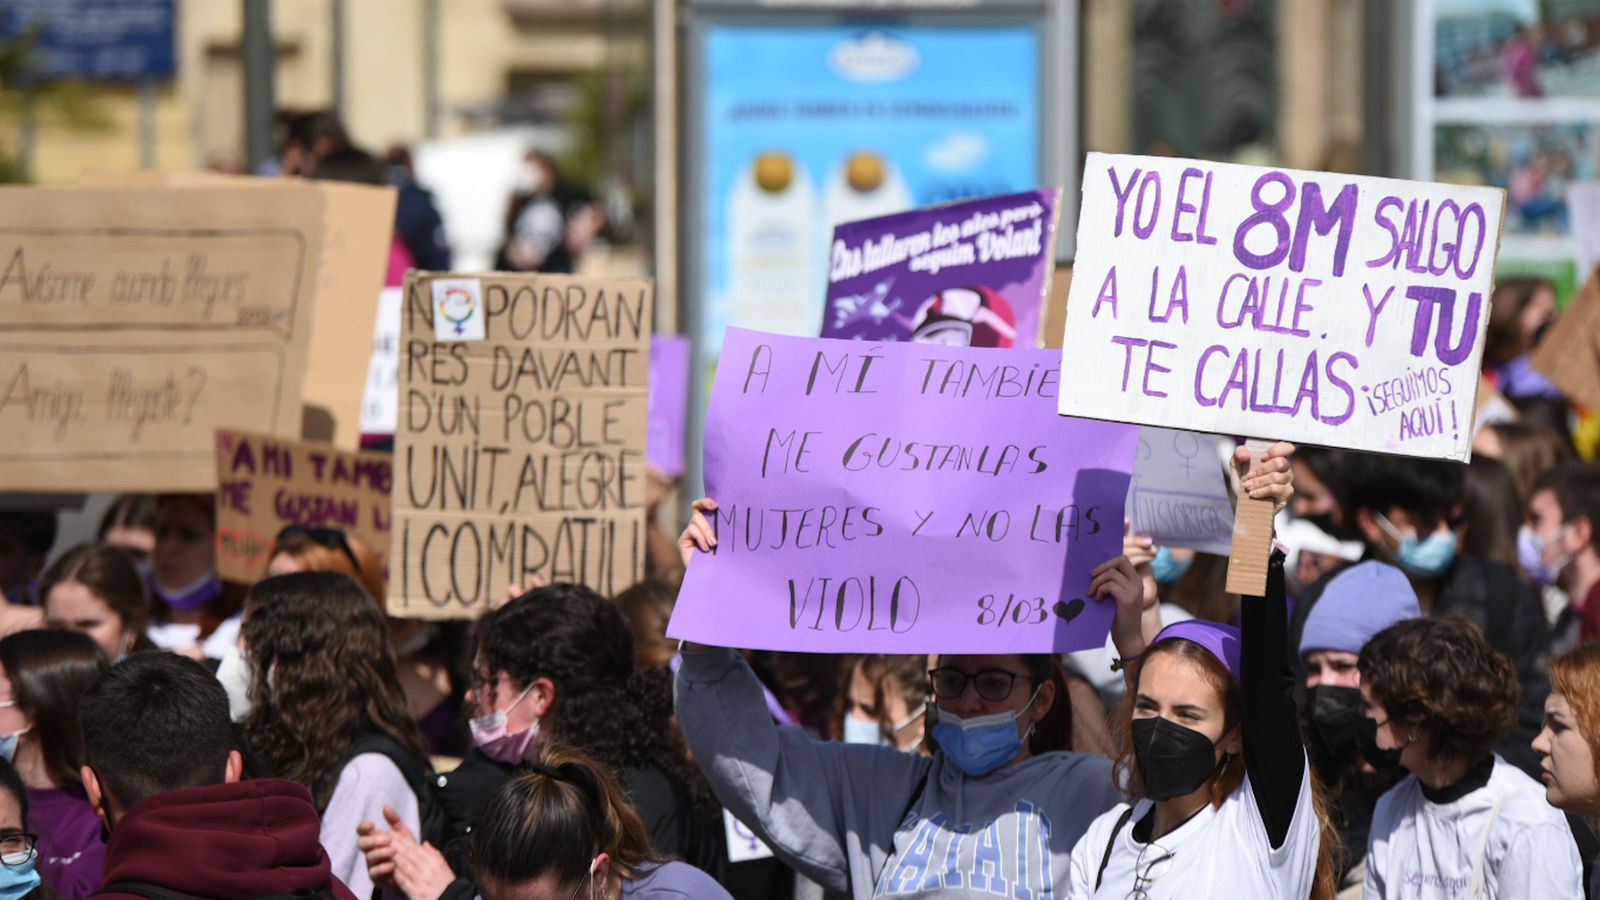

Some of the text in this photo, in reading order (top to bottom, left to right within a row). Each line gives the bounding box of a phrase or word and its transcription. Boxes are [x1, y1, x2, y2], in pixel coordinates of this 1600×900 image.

[1107, 166, 1486, 280] YO EL 8M SALGO
[485, 284, 645, 342] PODRAN
[1092, 265, 1482, 366] A LA CALLE. Y TU
[407, 341, 468, 387] RES
[491, 345, 637, 393] DAVANT
[743, 345, 1060, 400] A MÍ TAMBIÉ
[1110, 335, 1359, 426] TE CALLAS
[408, 389, 625, 449] D'UN POBLE
[232, 438, 256, 475] A
[761, 428, 823, 478] ME
[712, 504, 1101, 555] MUJERES Y NO LAS
[788, 575, 1049, 633] VIOLO 8/03
